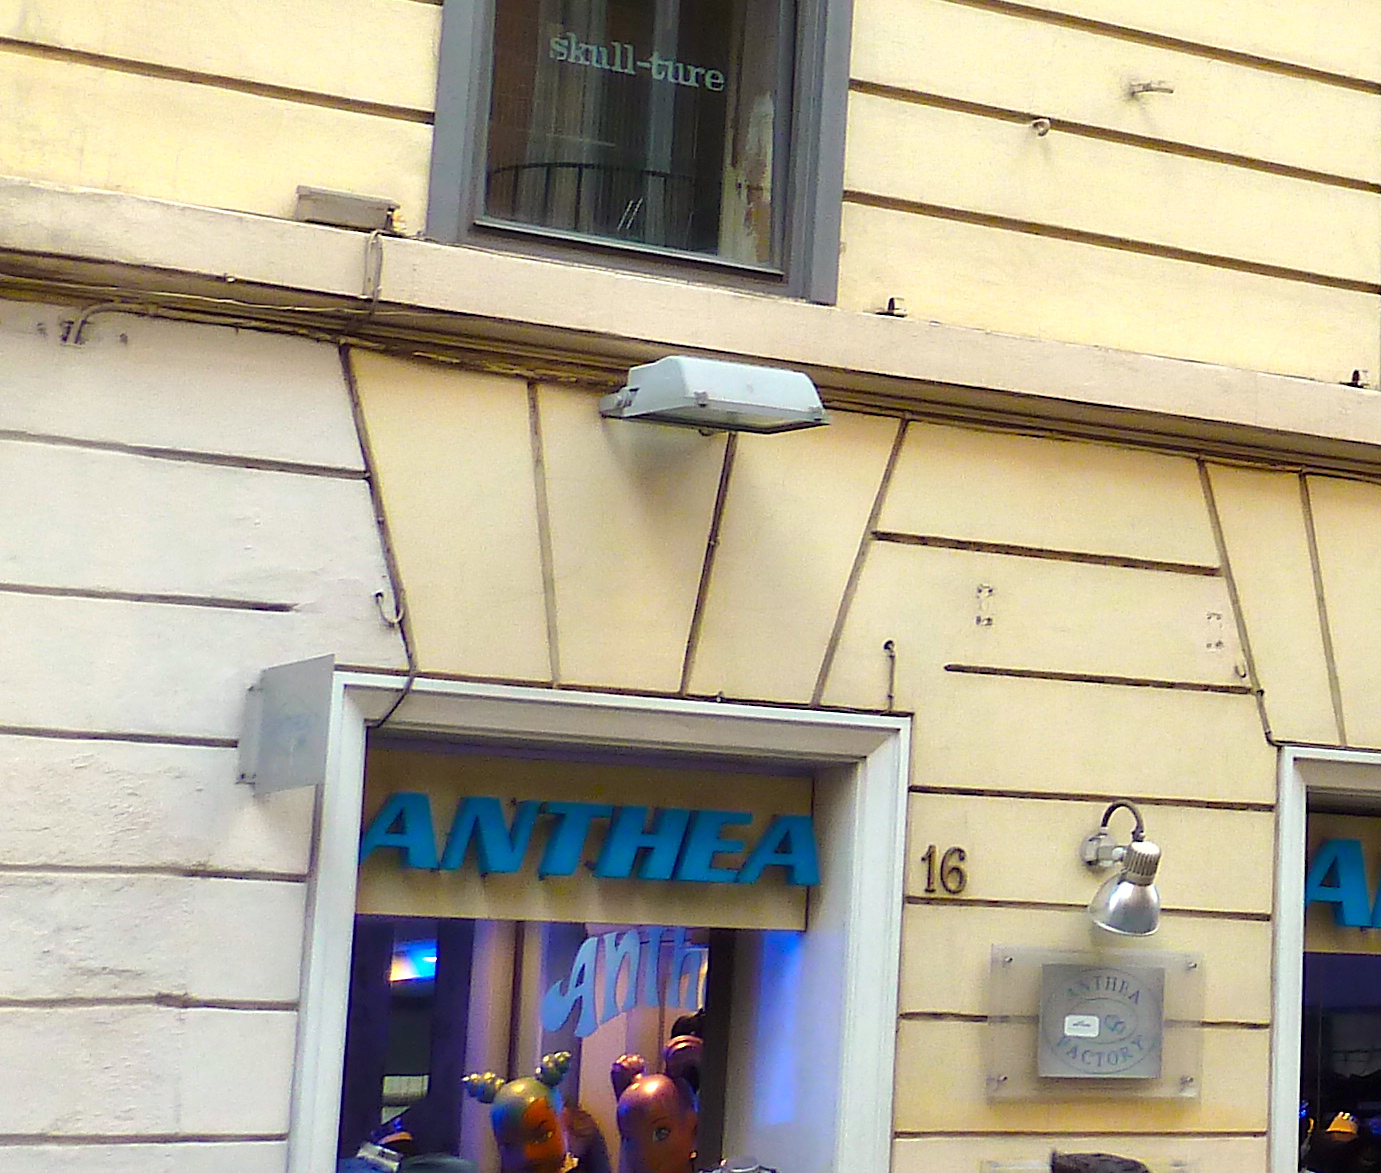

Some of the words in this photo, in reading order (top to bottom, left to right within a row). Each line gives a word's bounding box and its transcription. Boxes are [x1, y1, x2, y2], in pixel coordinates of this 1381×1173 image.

[549, 32, 726, 92] skull-ture
[360, 791, 821, 886] ANTHEA
[921, 845, 967, 896] 16
[1066, 976, 1141, 1004] ANTHEA
[1056, 1035, 1144, 1067] FACTORY
